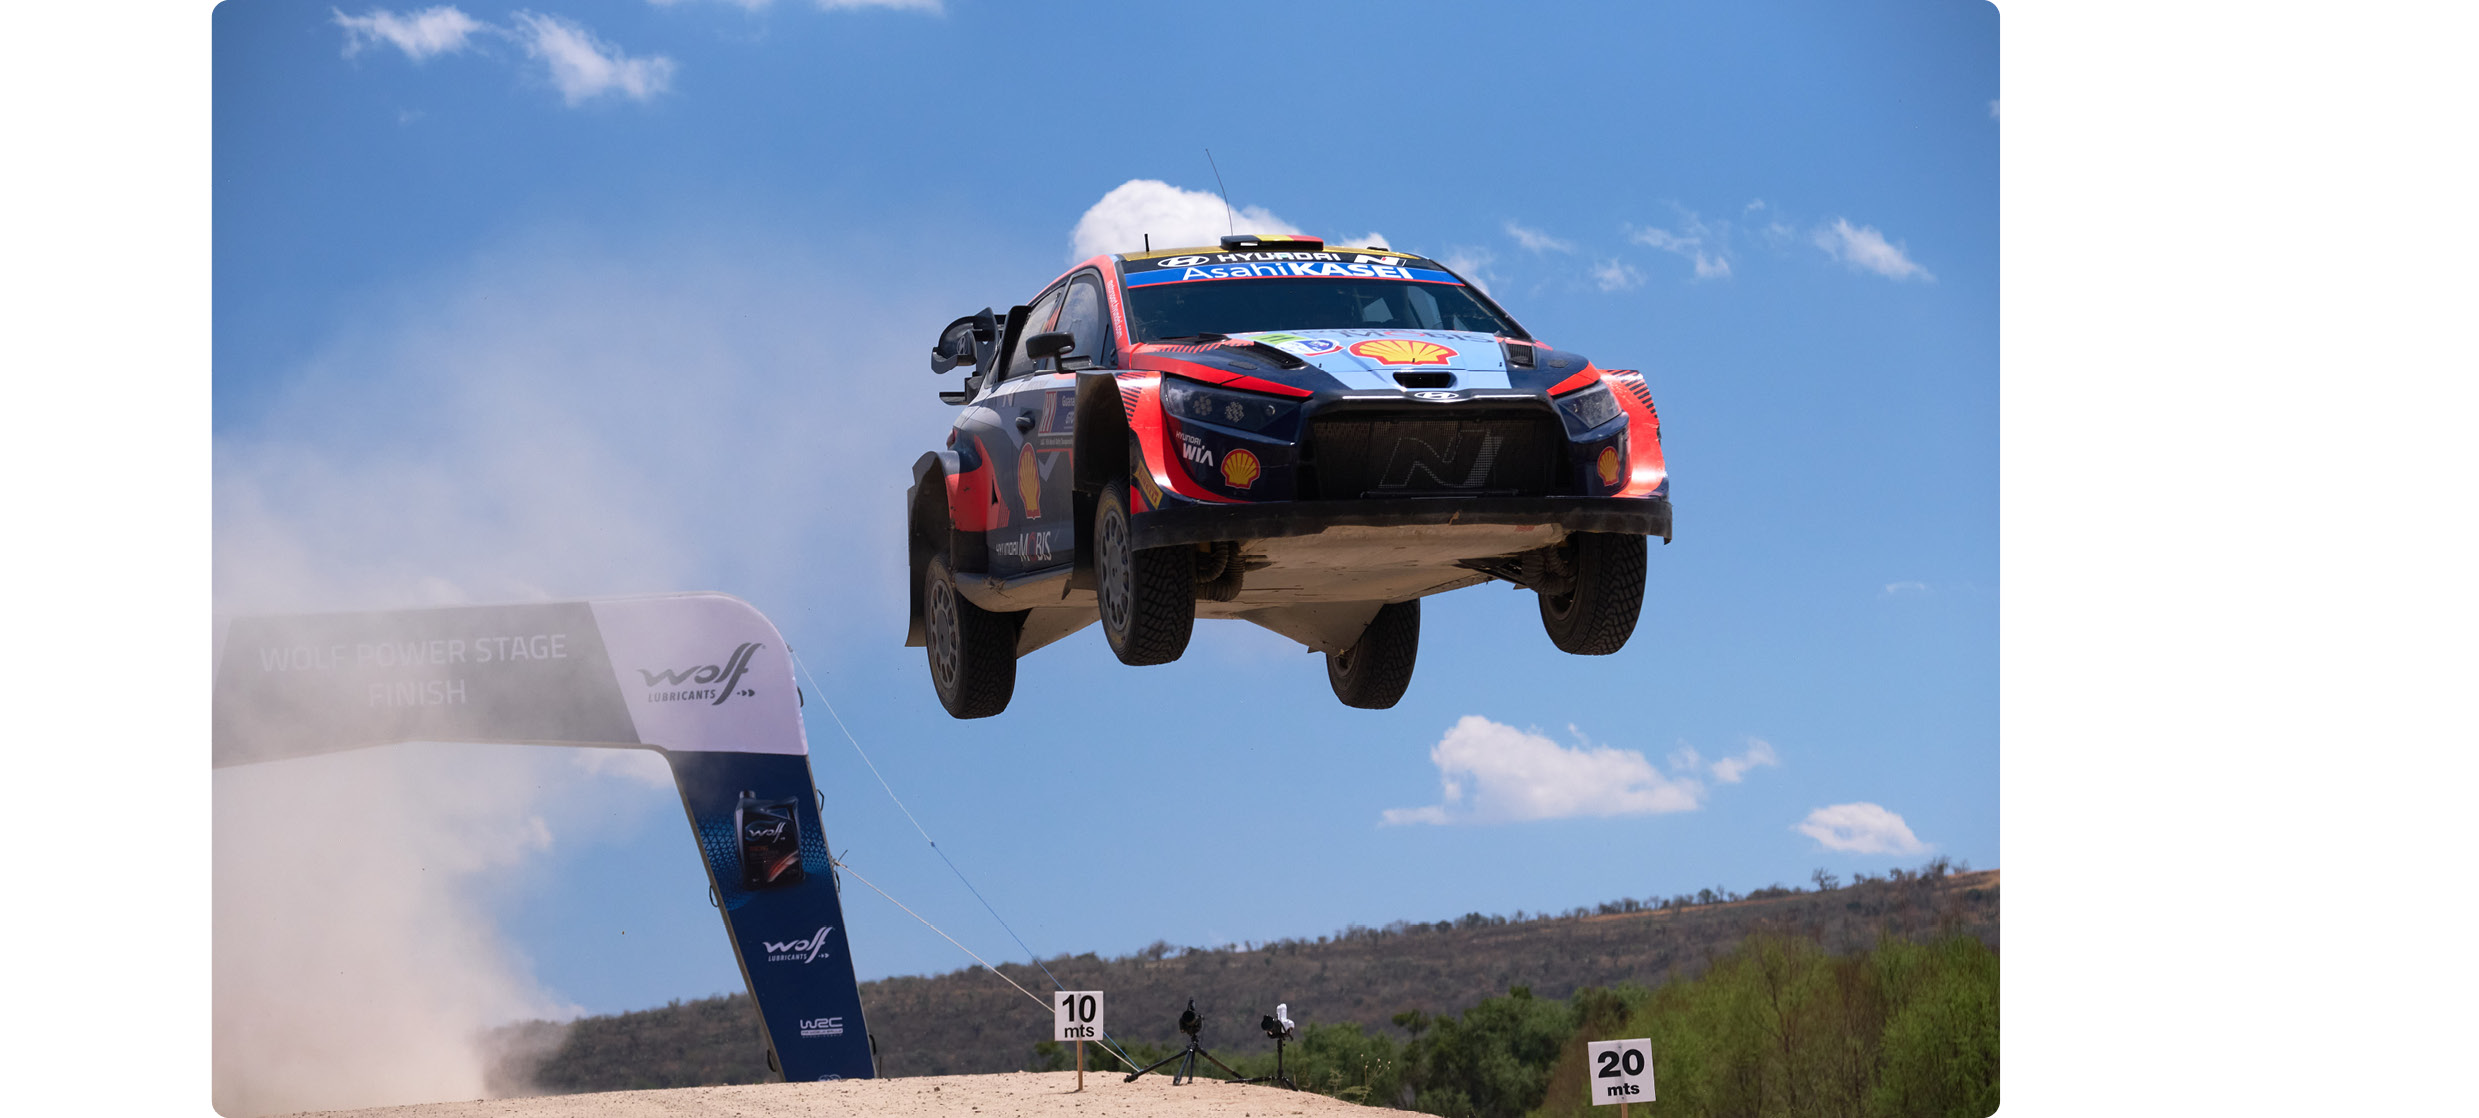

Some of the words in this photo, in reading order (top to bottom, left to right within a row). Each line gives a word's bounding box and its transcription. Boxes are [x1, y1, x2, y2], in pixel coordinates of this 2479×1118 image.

[1216, 251, 1342, 263] HYUNDAI
[1176, 430, 1202, 446] HYUNDAI
[1019, 531, 1052, 562] MOBIS
[259, 645, 355, 673] WOLF
[356, 638, 466, 667] POWER
[474, 633, 568, 663] STAGE
[367, 678, 467, 707] FINISH
[648, 689, 716, 703] LUBRICANTS
[768, 953, 808, 962] LUBRICANTS
[1062, 994, 1097, 1023] 10
[800, 1016, 843, 1029] WRC
[1064, 1024, 1095, 1038] mts
[1597, 1048, 1646, 1079] 20
[1607, 1082, 1641, 1097] mts
